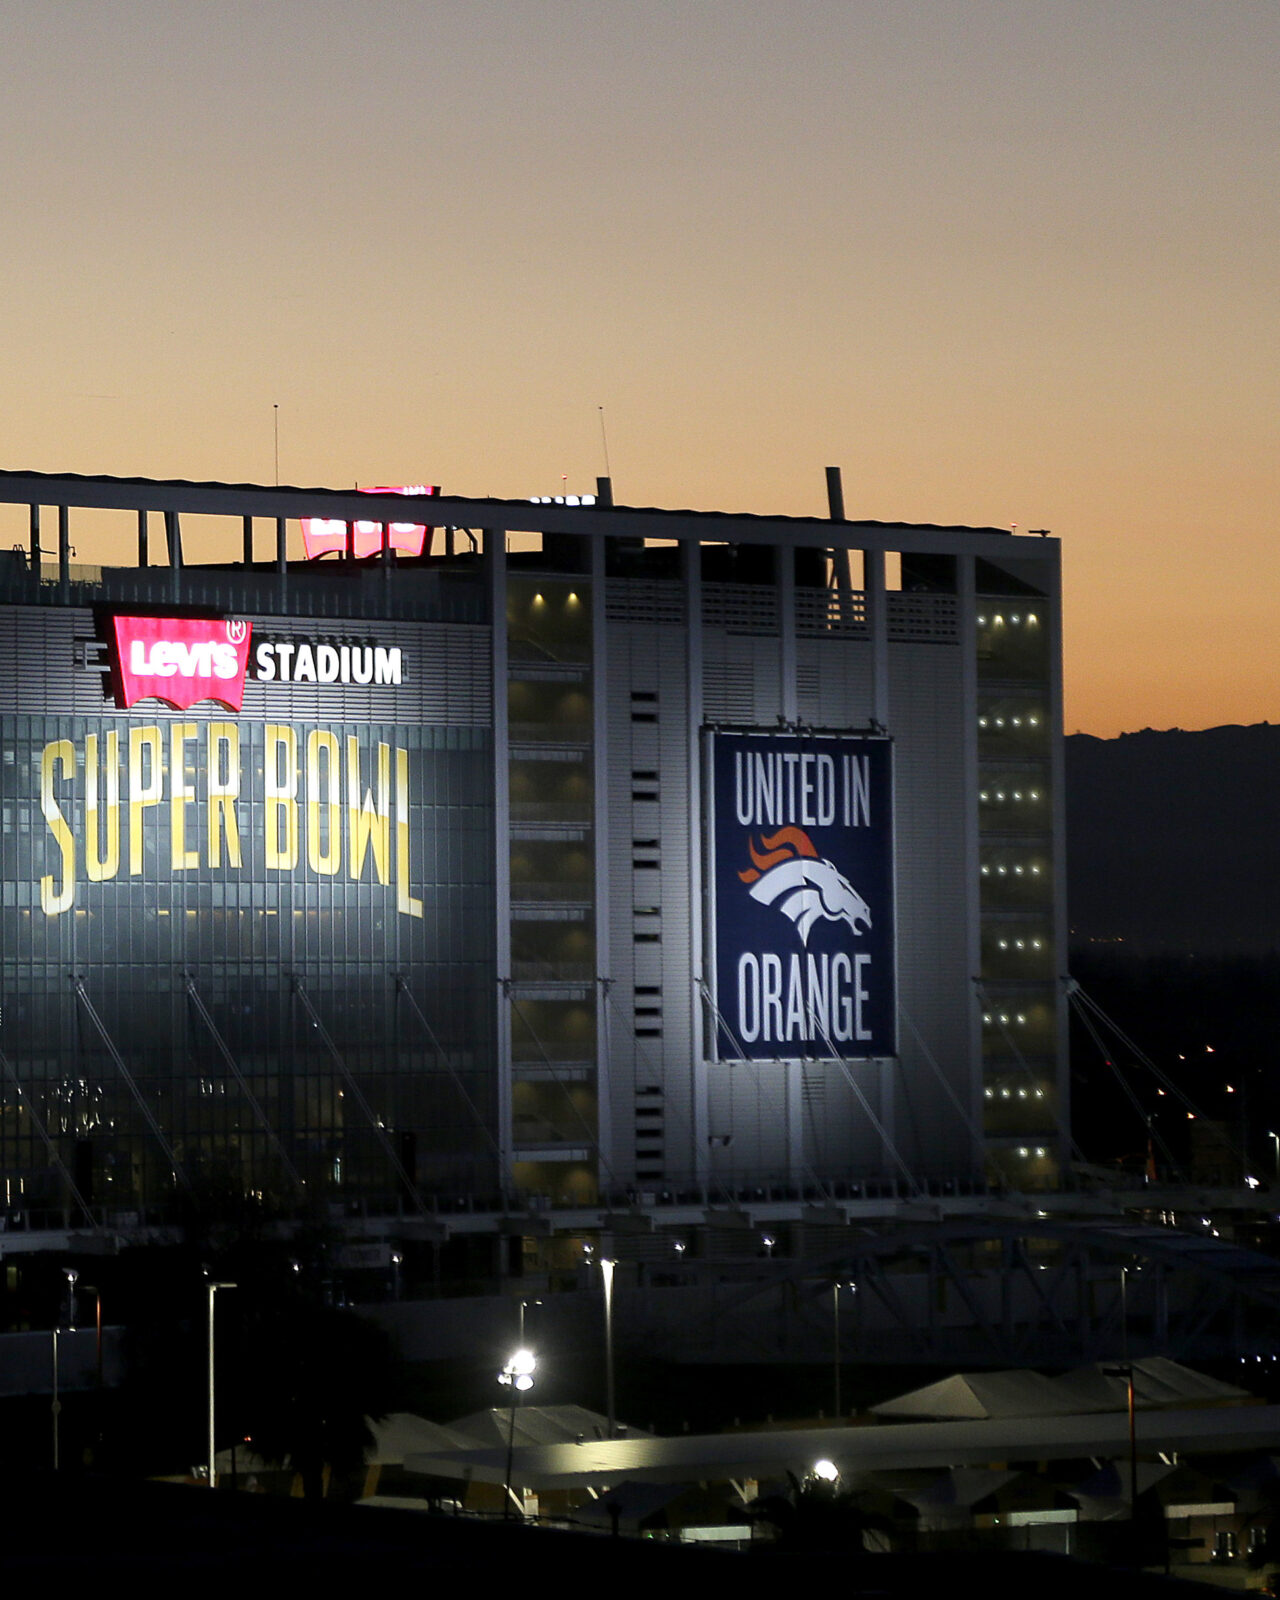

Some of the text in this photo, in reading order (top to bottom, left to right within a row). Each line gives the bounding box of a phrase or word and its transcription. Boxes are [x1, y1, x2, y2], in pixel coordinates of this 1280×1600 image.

[255, 643, 403, 685] STADIUM
[40, 722, 423, 919] SUPER BOWL
[735, 751, 871, 828] UNITED IN
[738, 952, 873, 1044] ORANGE
